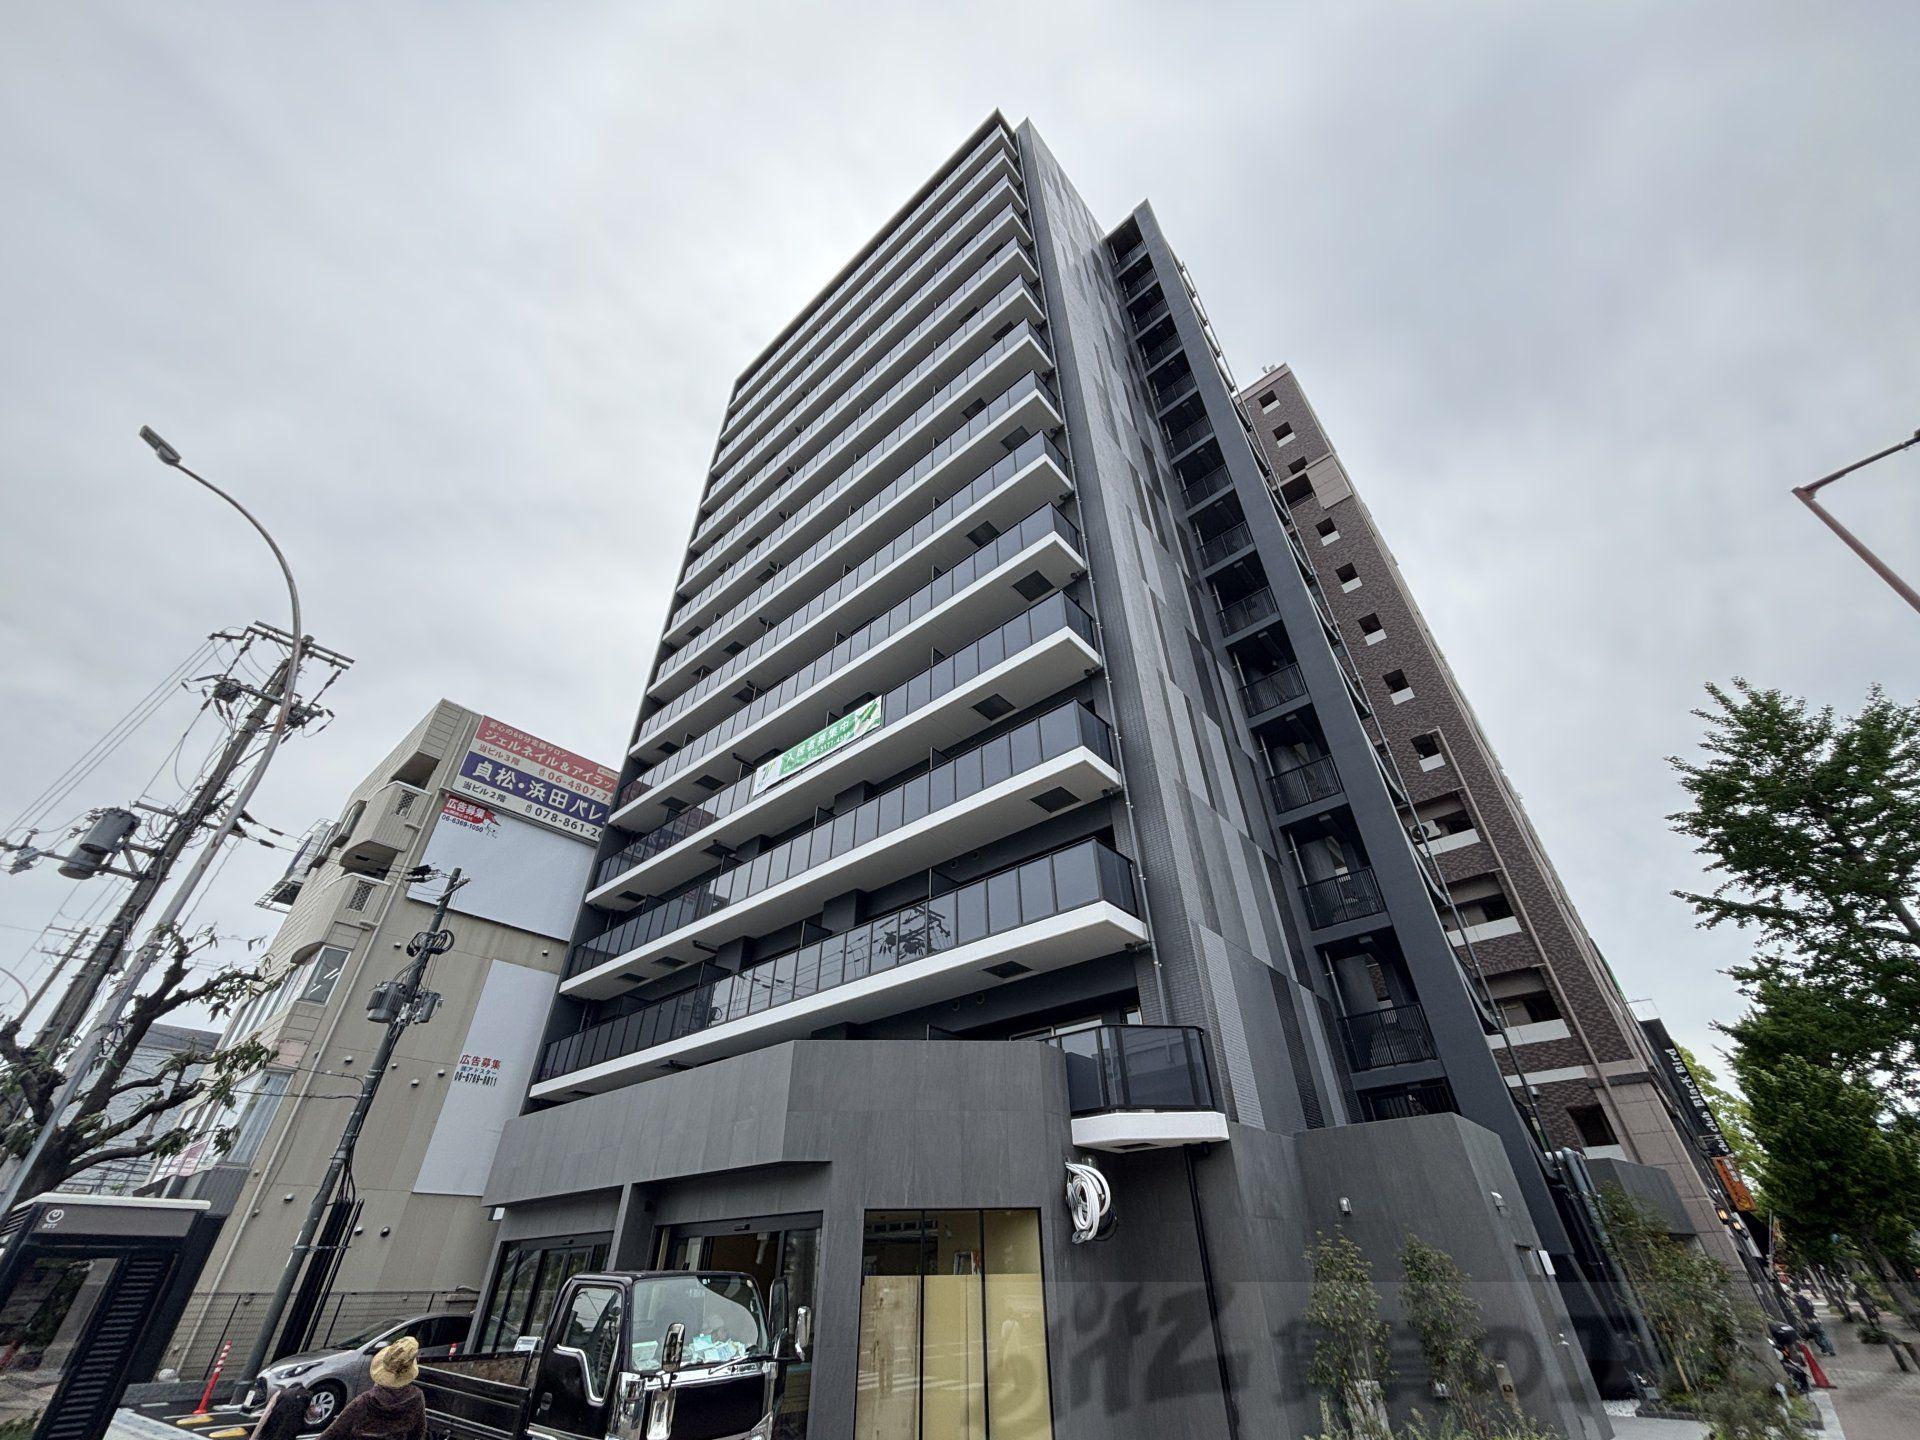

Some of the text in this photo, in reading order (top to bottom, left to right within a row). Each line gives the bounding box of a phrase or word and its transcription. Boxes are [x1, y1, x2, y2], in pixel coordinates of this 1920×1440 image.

[484, 729, 616, 790] ジェルネイル&アイラッ
[472, 760, 606, 826] 貞松・浜田バレ
[547, 771, 614, 802] 06-4807-7
[459, 1054, 501, 1070] 広告募集
[1664, 1048, 1687, 1074] Bird
